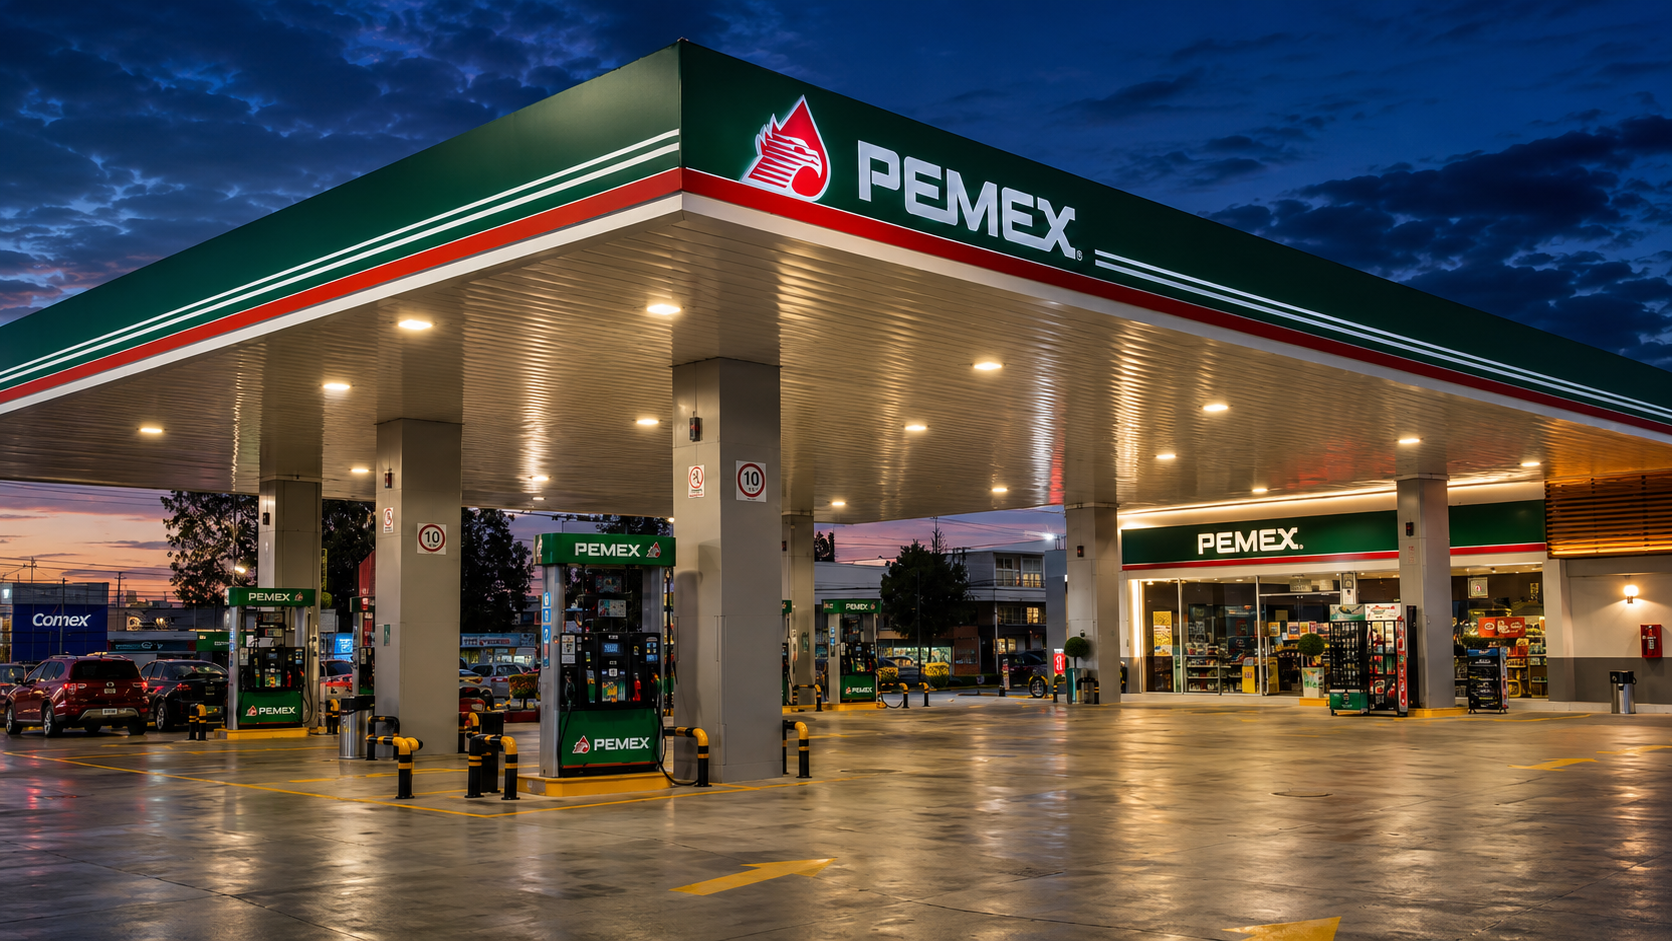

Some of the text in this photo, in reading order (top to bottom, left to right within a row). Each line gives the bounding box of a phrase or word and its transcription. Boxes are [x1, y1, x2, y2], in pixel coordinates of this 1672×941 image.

[857, 139, 1076, 260] PEMEX
[744, 470, 759, 486] 10
[424, 530, 440, 543] 10
[1197, 526, 1299, 555] PEMEX
[575, 542, 640, 557] PEMEX
[248, 592, 290, 602] PEMEX
[32, 612, 91, 627] Comex
[258, 706, 296, 715] PEMEX
[594, 736, 650, 751] PEMEX
